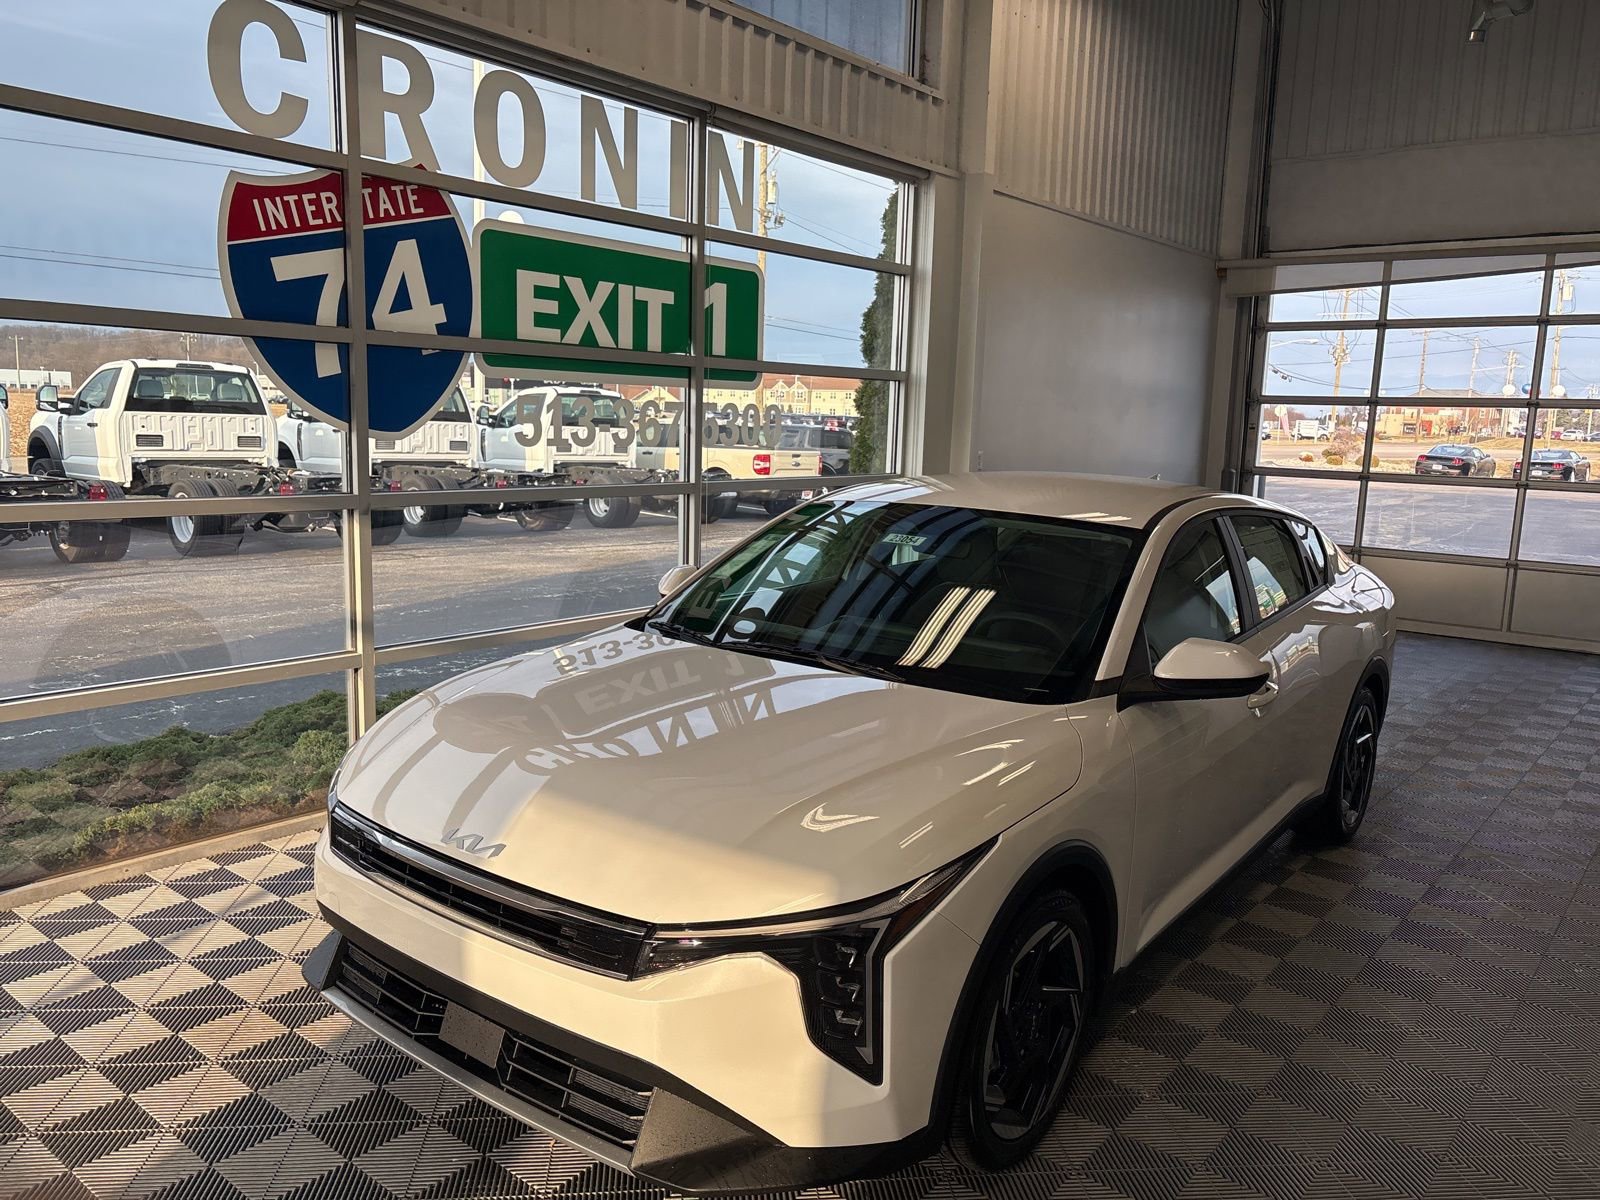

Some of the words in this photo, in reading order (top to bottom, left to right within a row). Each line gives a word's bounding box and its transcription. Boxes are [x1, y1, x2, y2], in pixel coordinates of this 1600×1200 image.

[207, 0, 757, 233] CRONIN
[252, 184, 425, 232] INTERTATE
[270, 238, 448, 379] 74
[516, 268, 675, 353] EXIT
[704, 281, 728, 357] 1
[514, 396, 782, 448] 513-3675300
